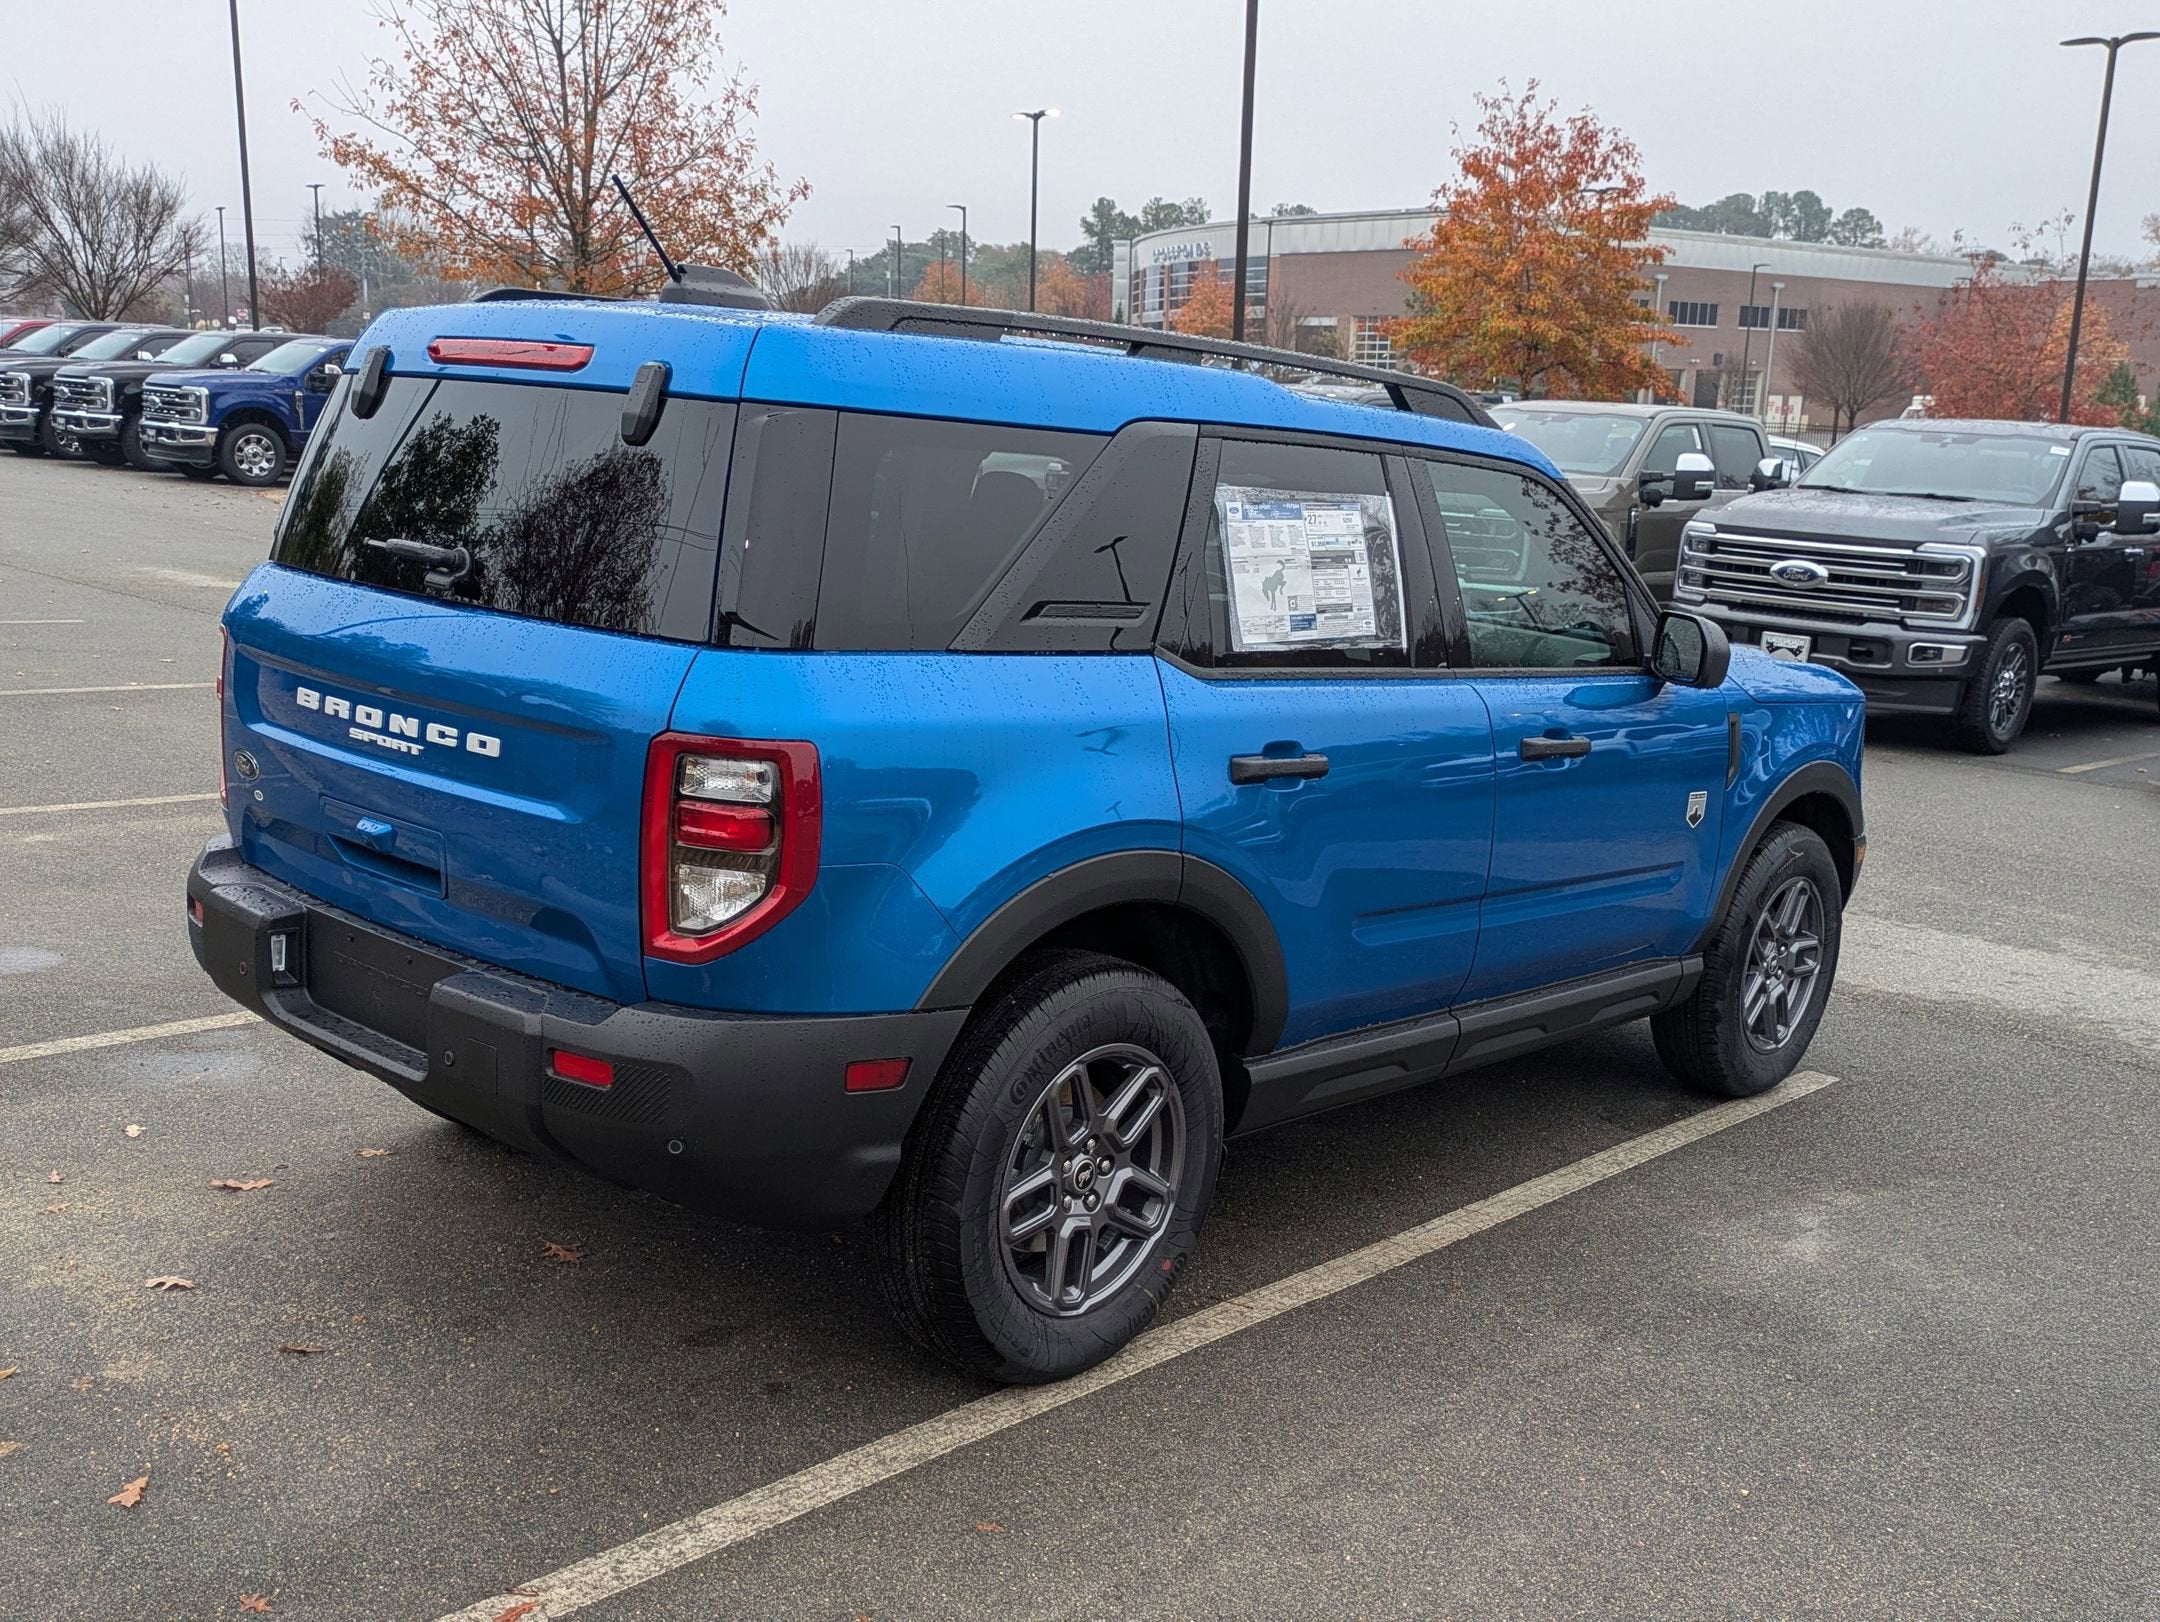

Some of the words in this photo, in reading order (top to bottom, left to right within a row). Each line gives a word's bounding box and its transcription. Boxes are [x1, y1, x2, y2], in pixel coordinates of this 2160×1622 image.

[1782, 567, 1811, 582] Ford
[297, 686, 501, 758] BRONCO
[349, 727, 424, 756] SPORT
